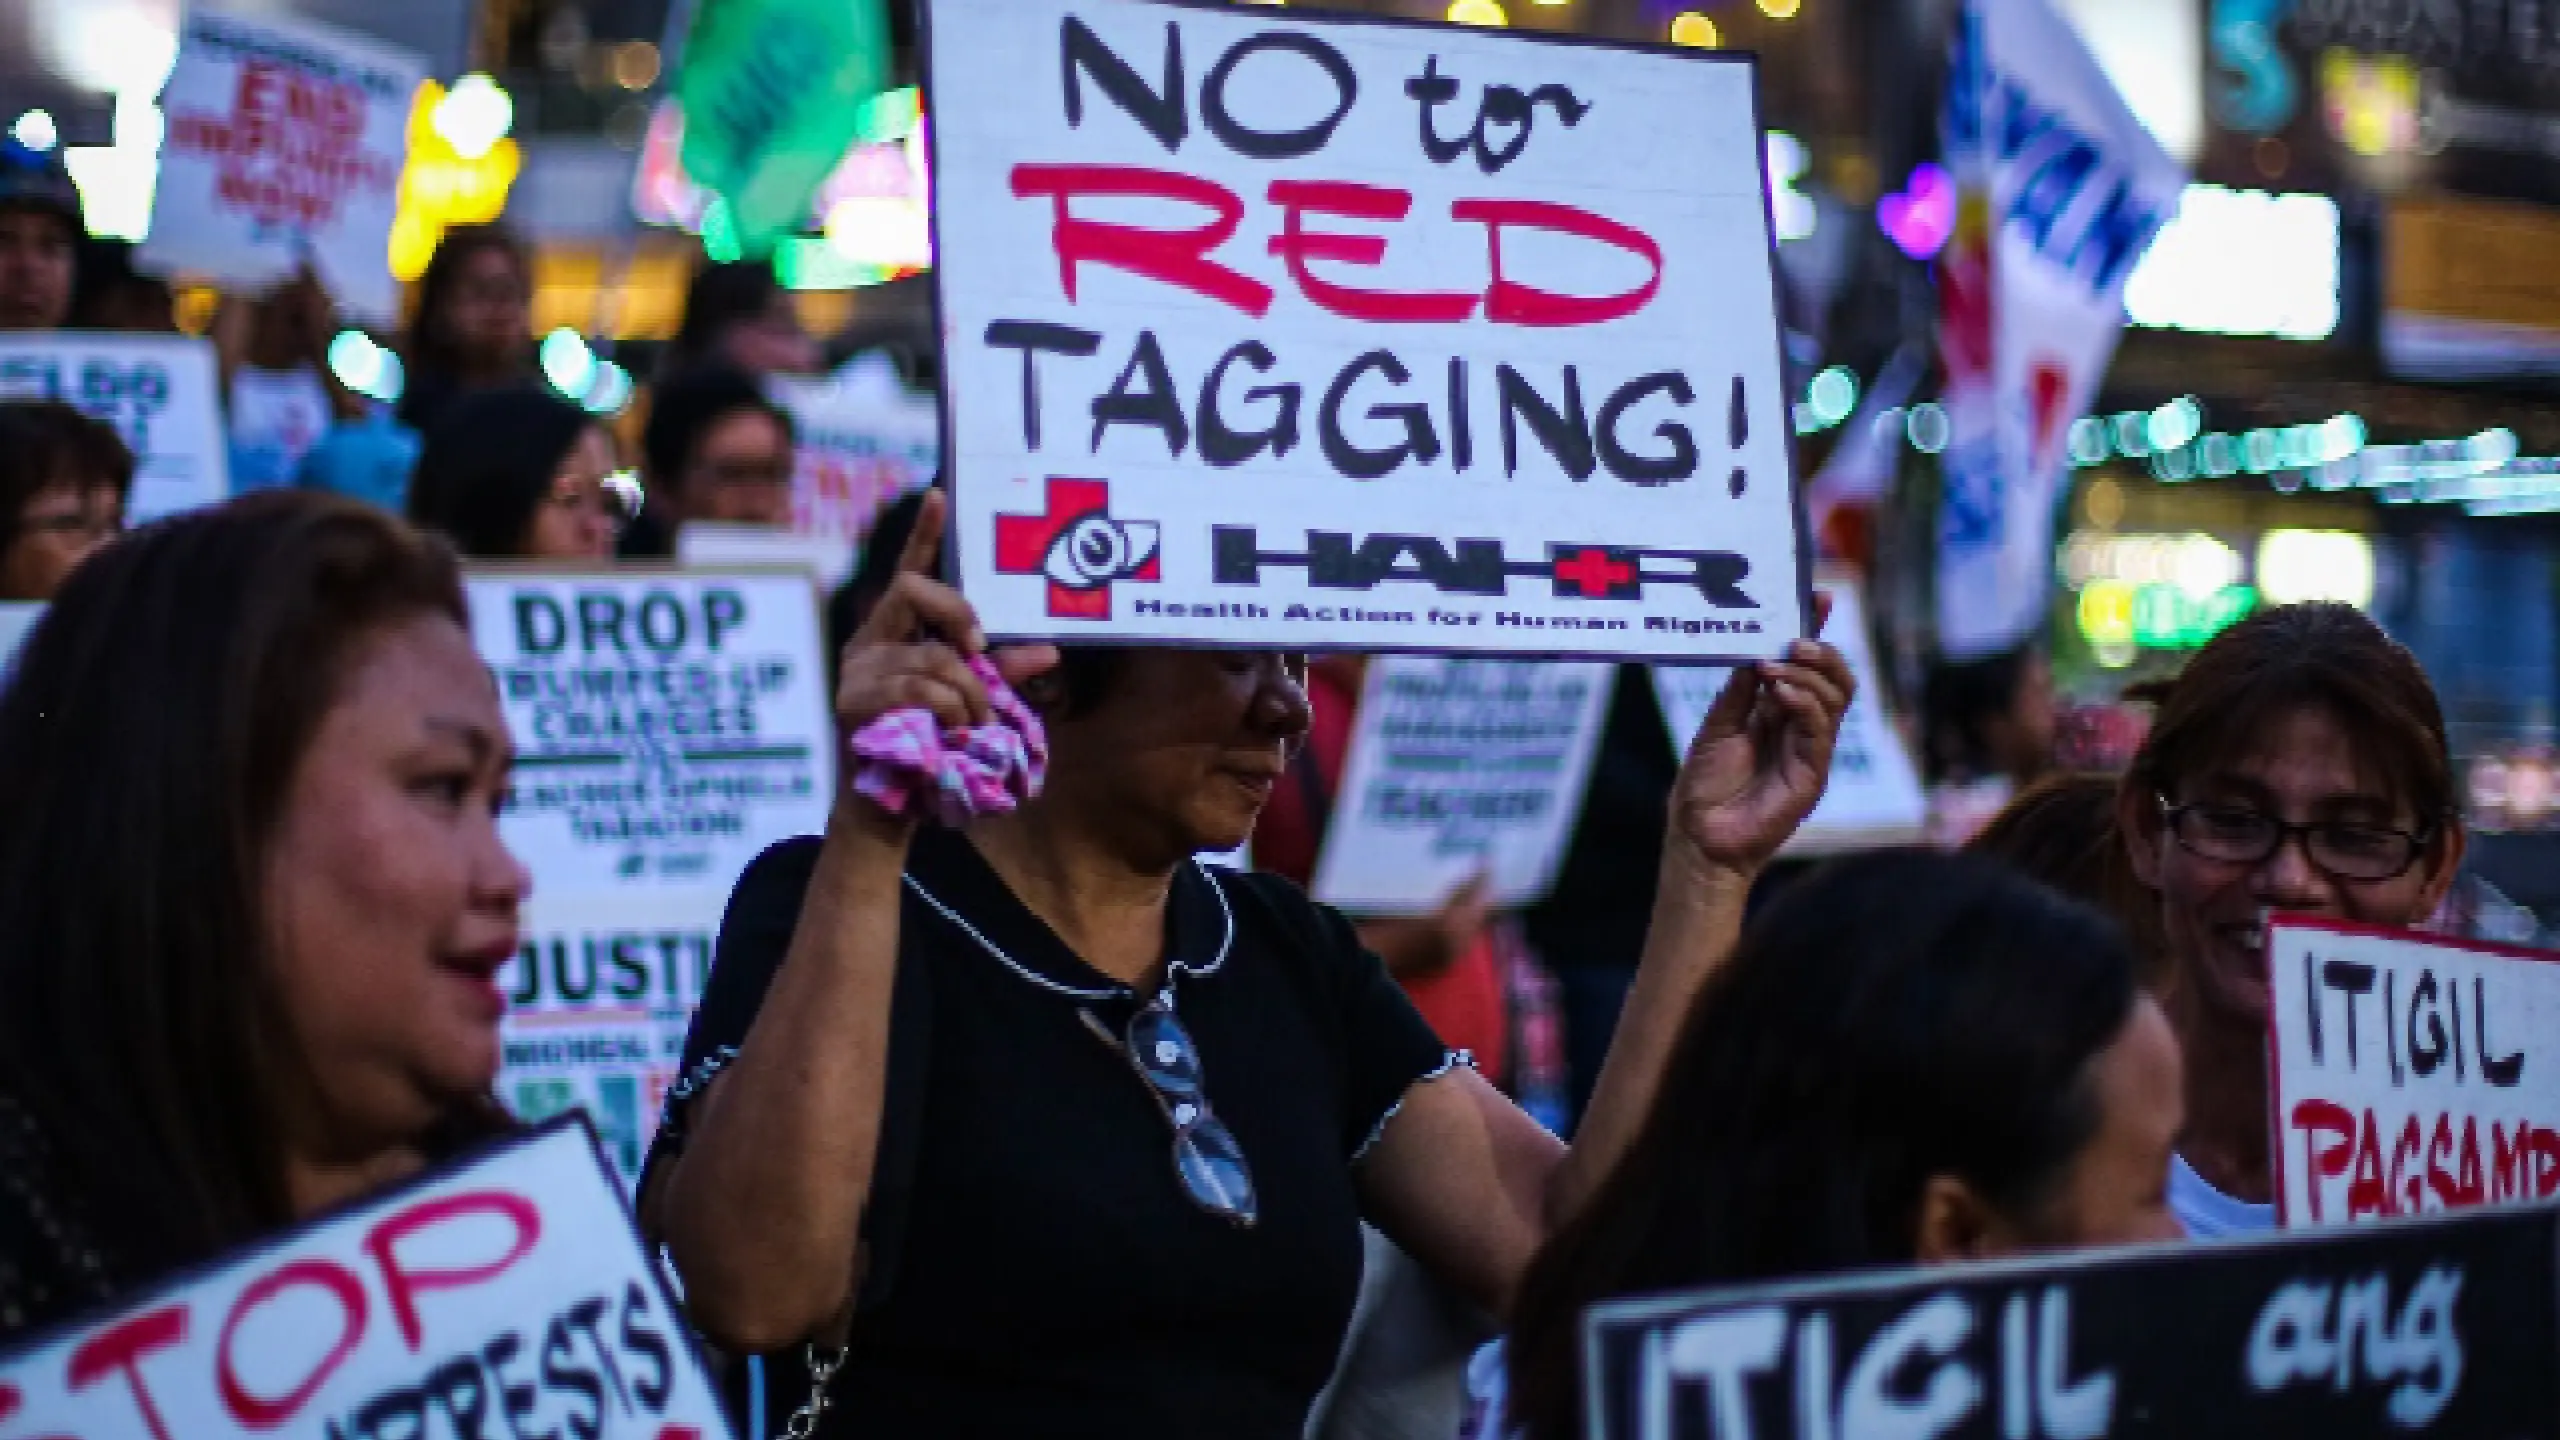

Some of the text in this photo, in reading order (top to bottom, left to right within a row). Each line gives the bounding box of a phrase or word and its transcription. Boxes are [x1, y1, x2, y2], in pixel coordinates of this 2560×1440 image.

[1060, 12, 1359, 160] NO
[1008, 163, 1662, 327] RED
[983, 318, 1749, 500] TAGGING!
[512, 589, 747, 656] DROP
[1133, 598, 1764, 638] Health Action for Human Rights
[2303, 950, 2526, 1089] ITIGIL
[2243, 1264, 2464, 1429] ang
